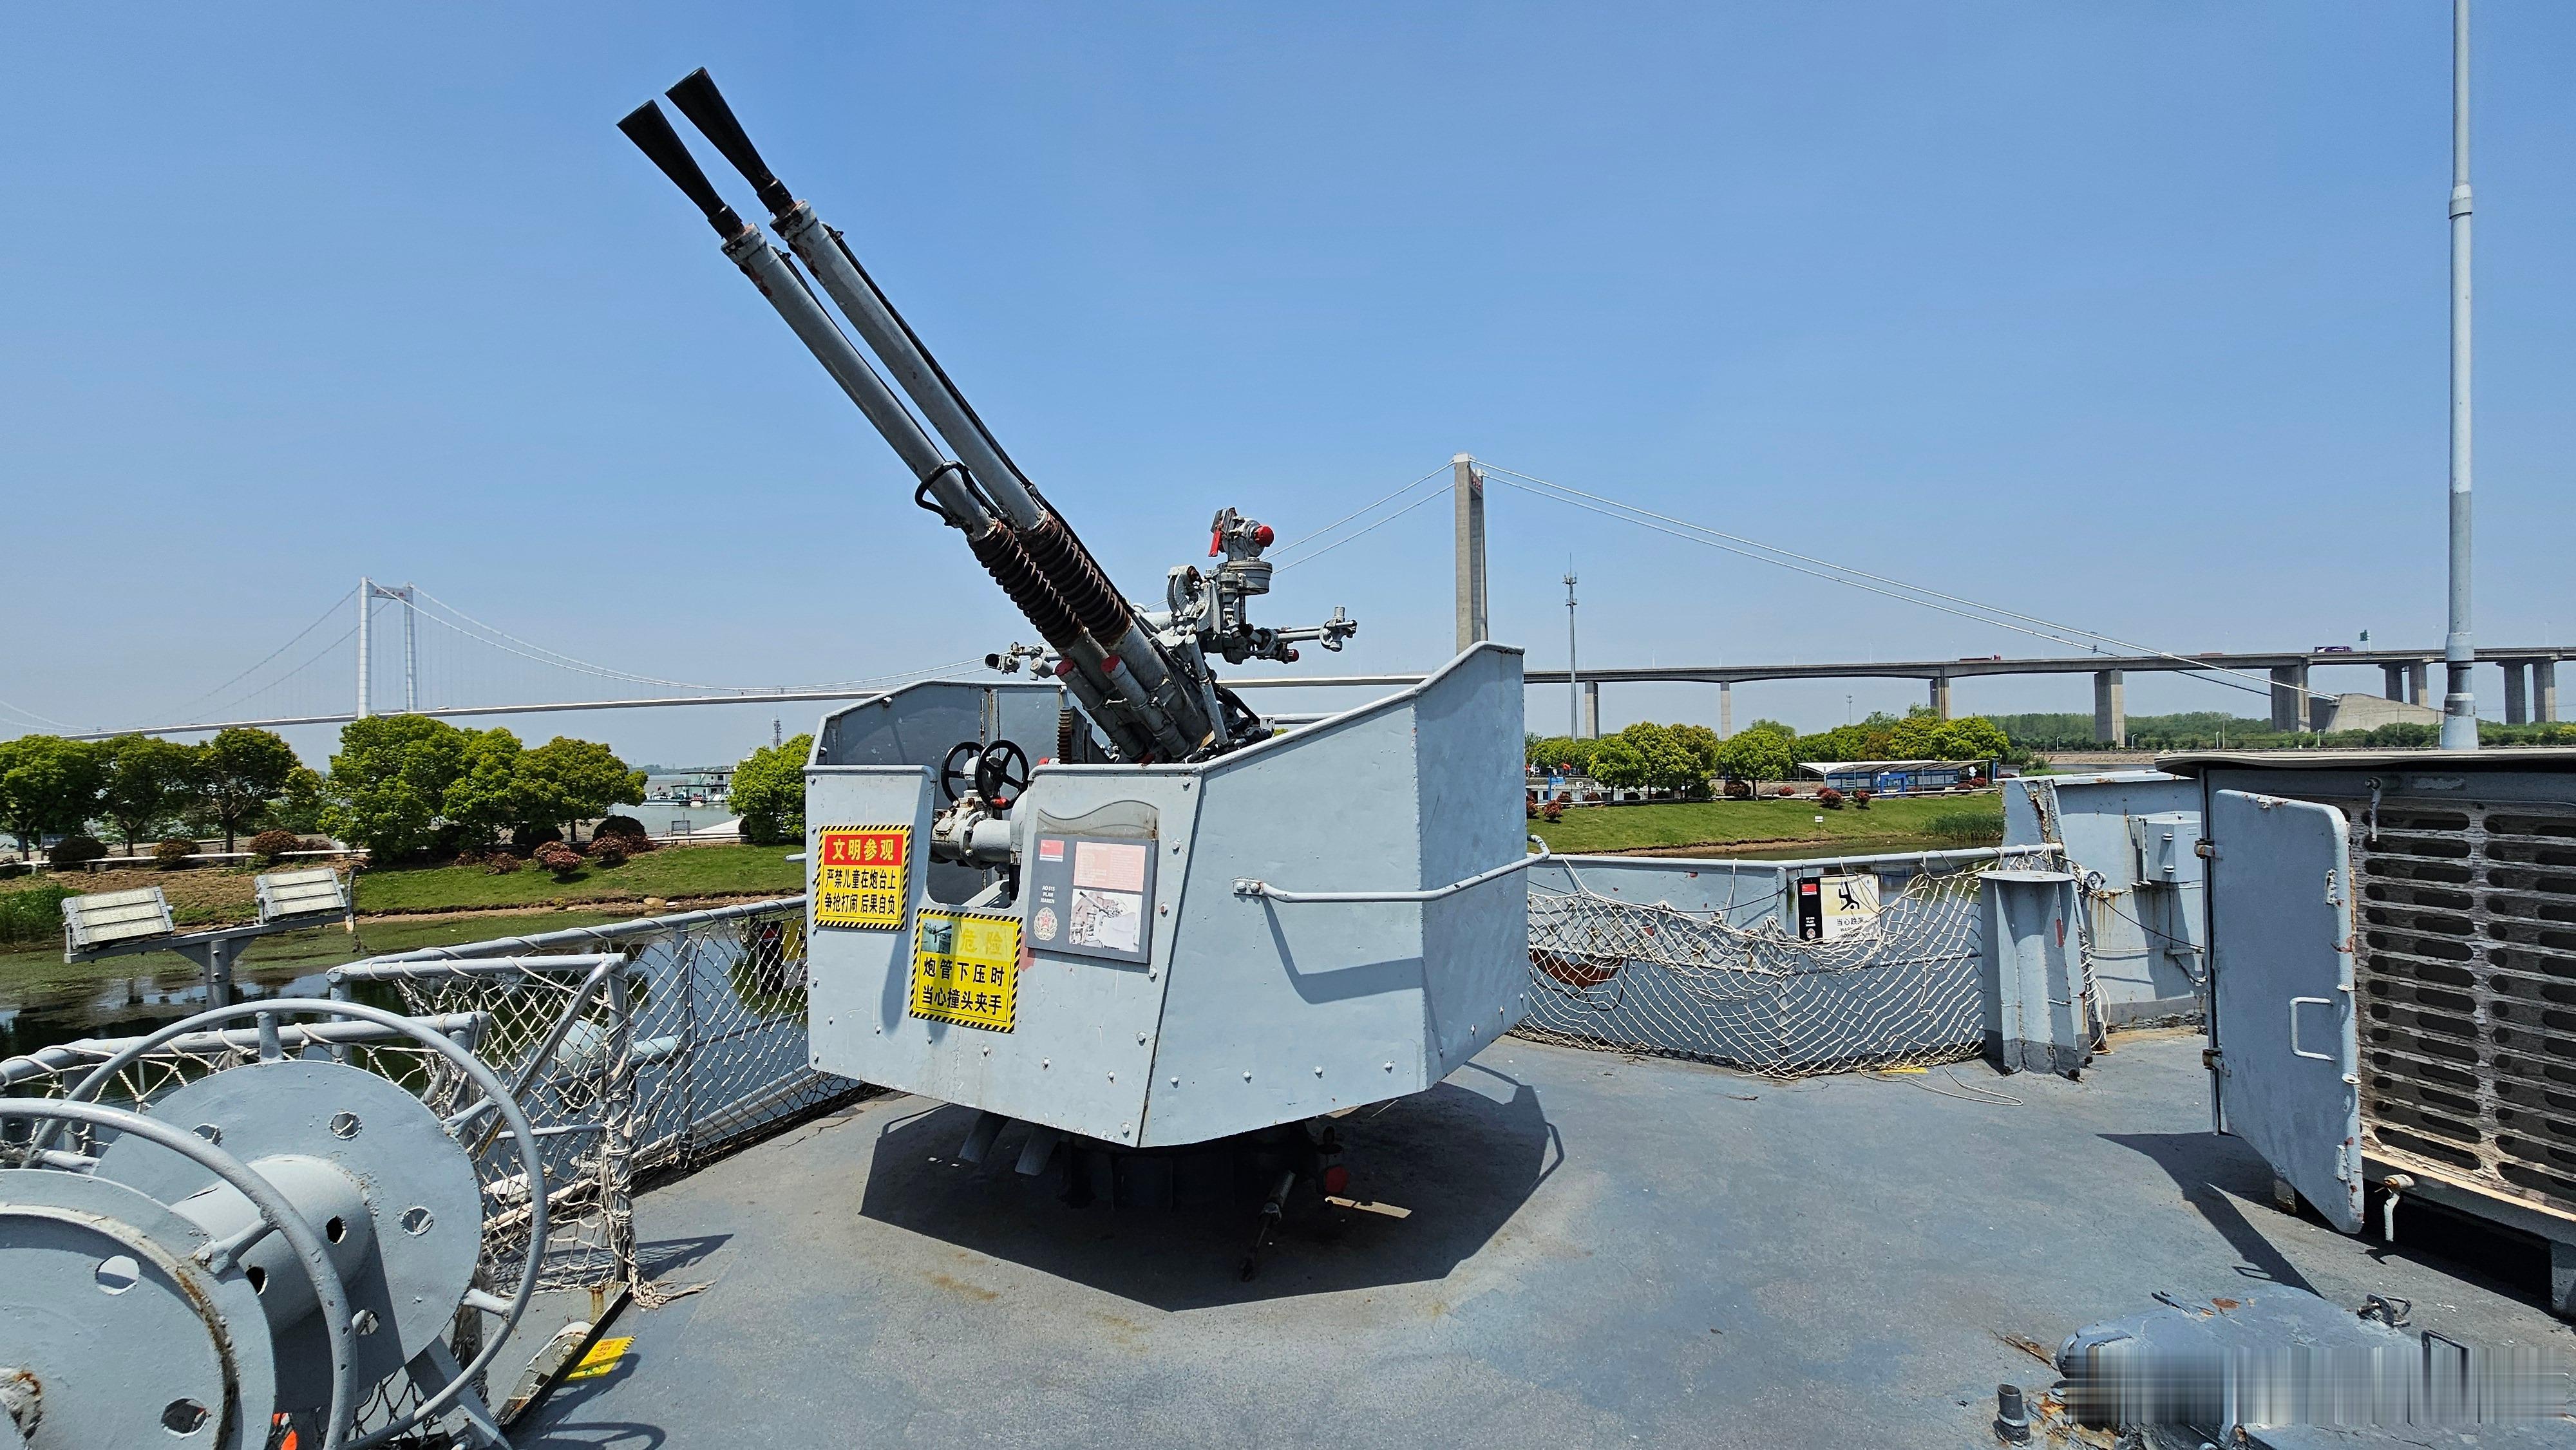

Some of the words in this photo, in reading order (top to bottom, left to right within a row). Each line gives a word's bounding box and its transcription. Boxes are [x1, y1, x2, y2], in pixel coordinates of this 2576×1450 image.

[832, 838, 894, 861] 文明参观
[825, 868, 896, 890] 严禁儿童在炮台上
[824, 891, 858, 912] 争抢打闹
[860, 894, 895, 915] 后果自负
[960, 929, 1003, 955] 危险
[923, 957, 1005, 987] 炮管下压时
[922, 984, 1003, 1015] 当心撞头夹手
